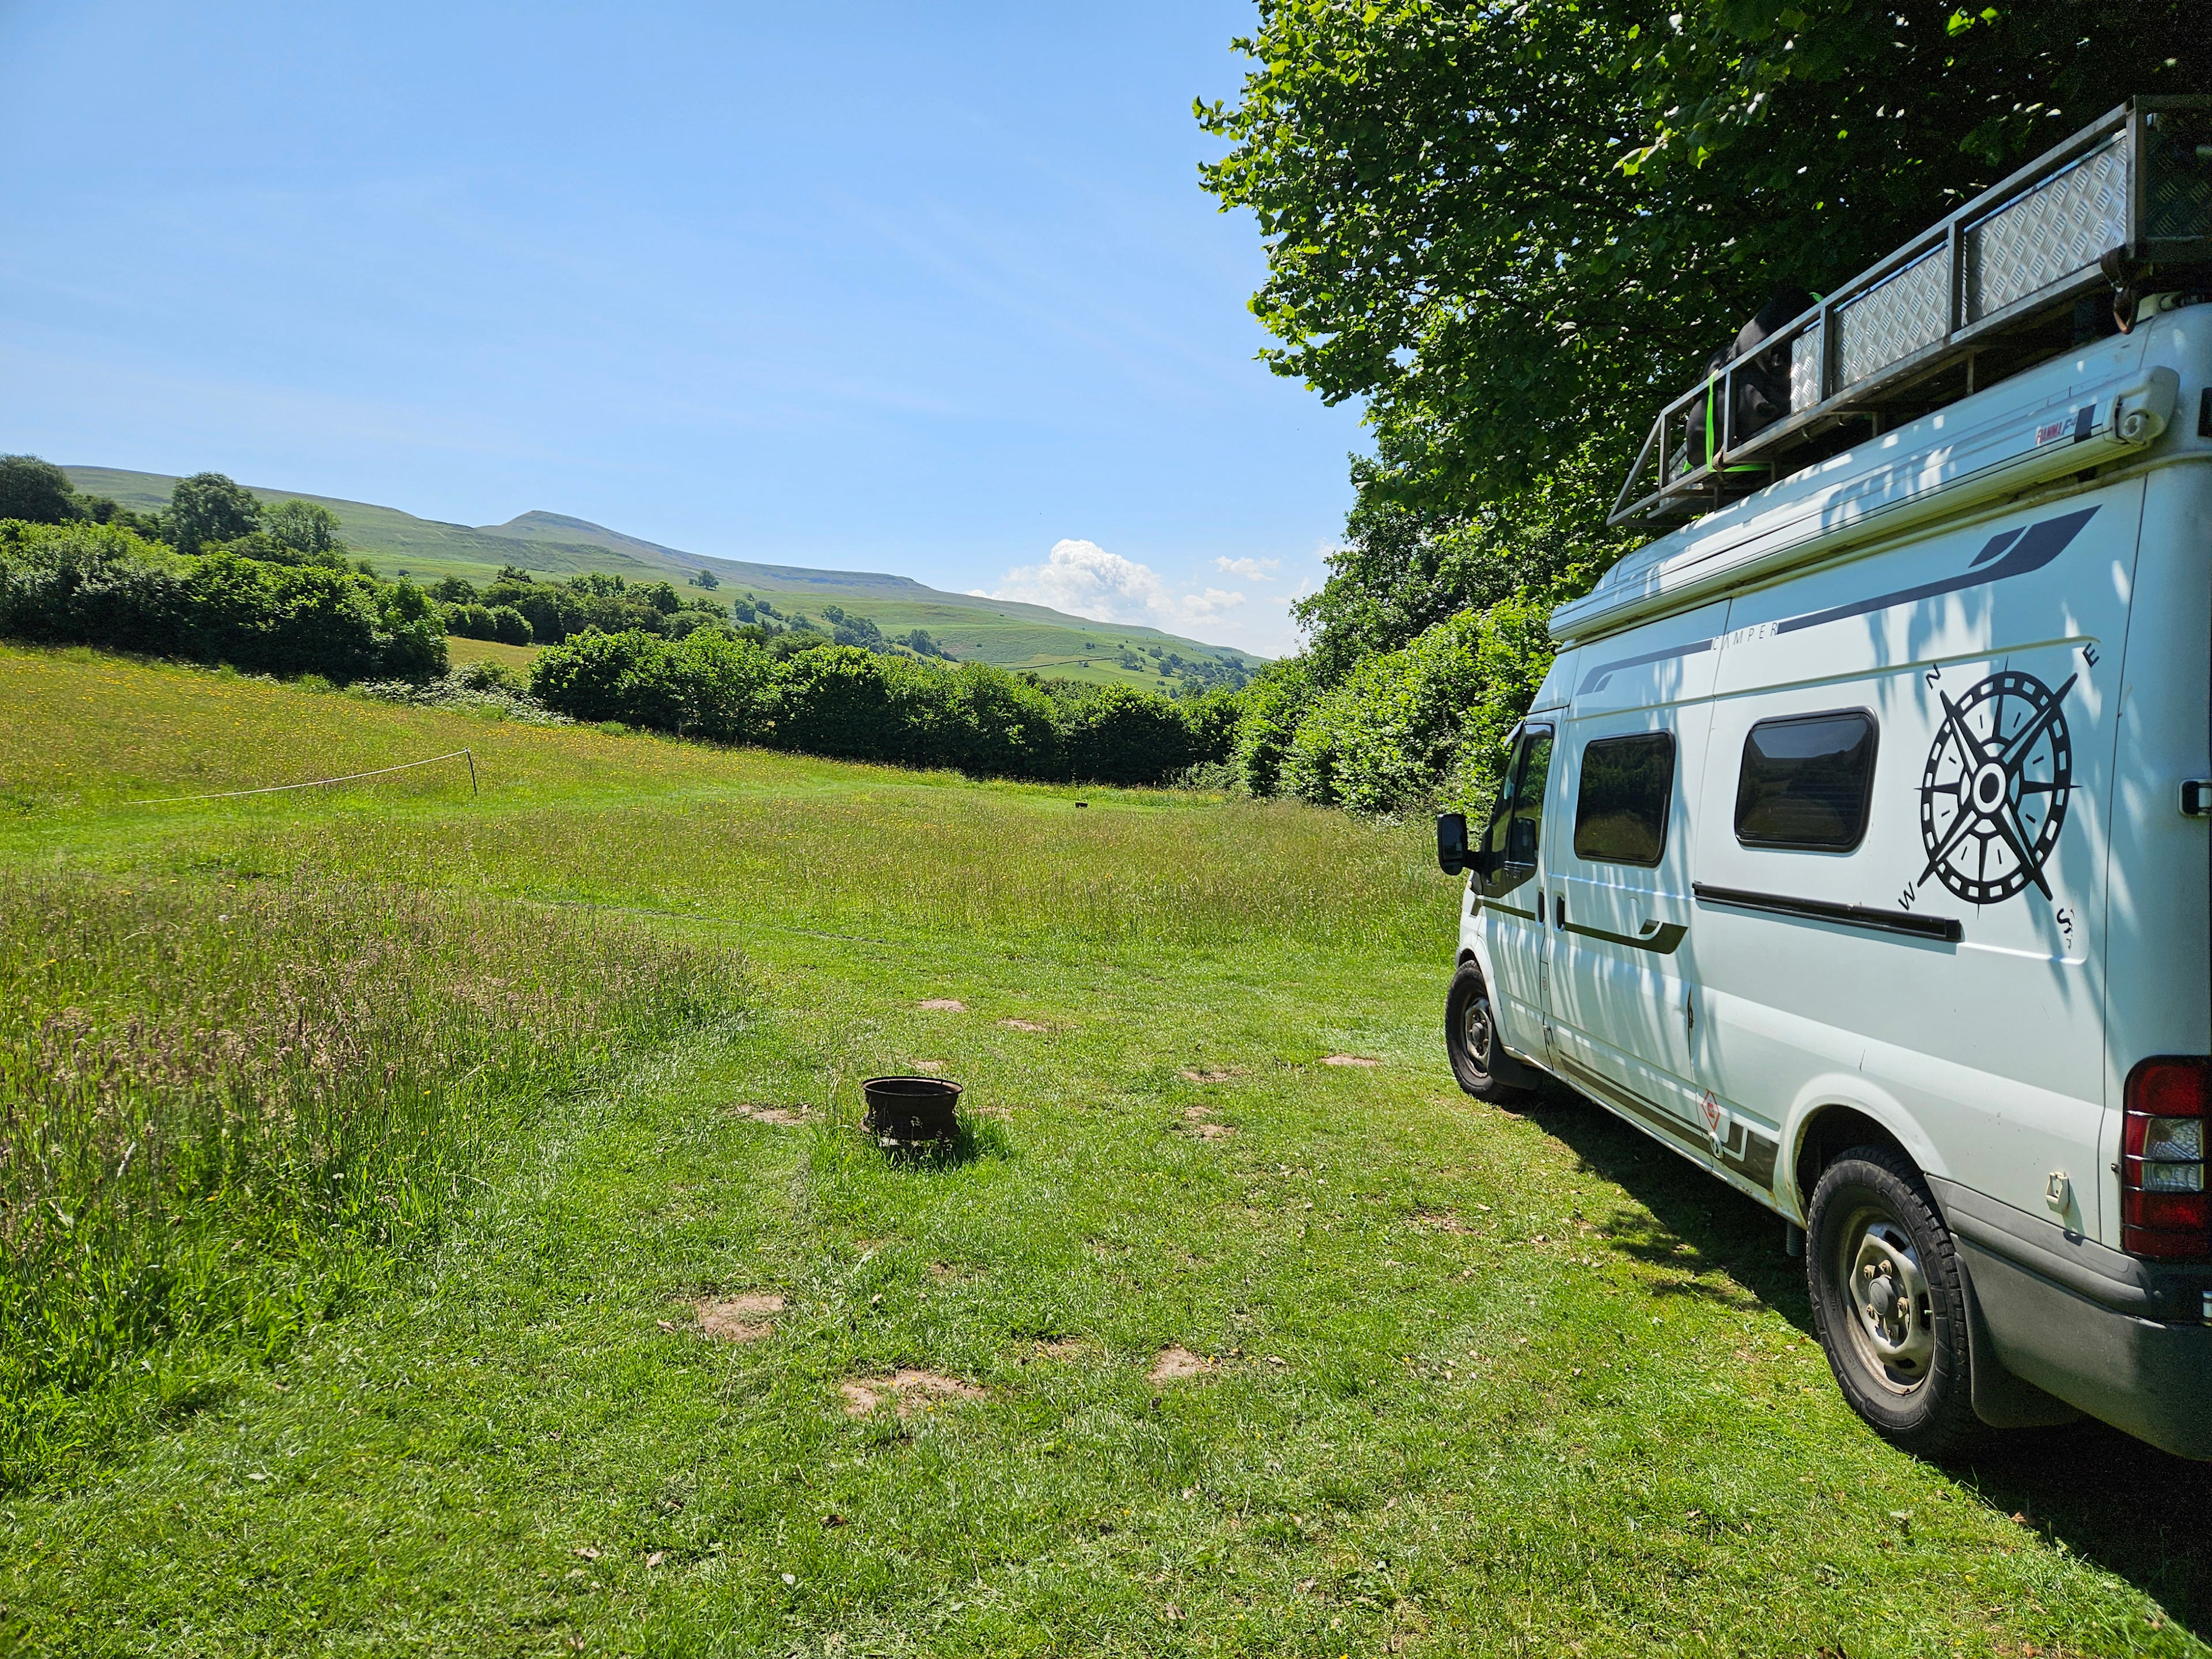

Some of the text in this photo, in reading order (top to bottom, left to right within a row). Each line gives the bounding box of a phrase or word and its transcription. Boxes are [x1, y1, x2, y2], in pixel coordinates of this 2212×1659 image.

[1713, 623, 1778, 650] CAMPER
[2082, 642, 2100, 668] E
[1926, 663, 1942, 690] N
[1898, 881, 1916, 911] W
[2056, 908, 2071, 933] S
